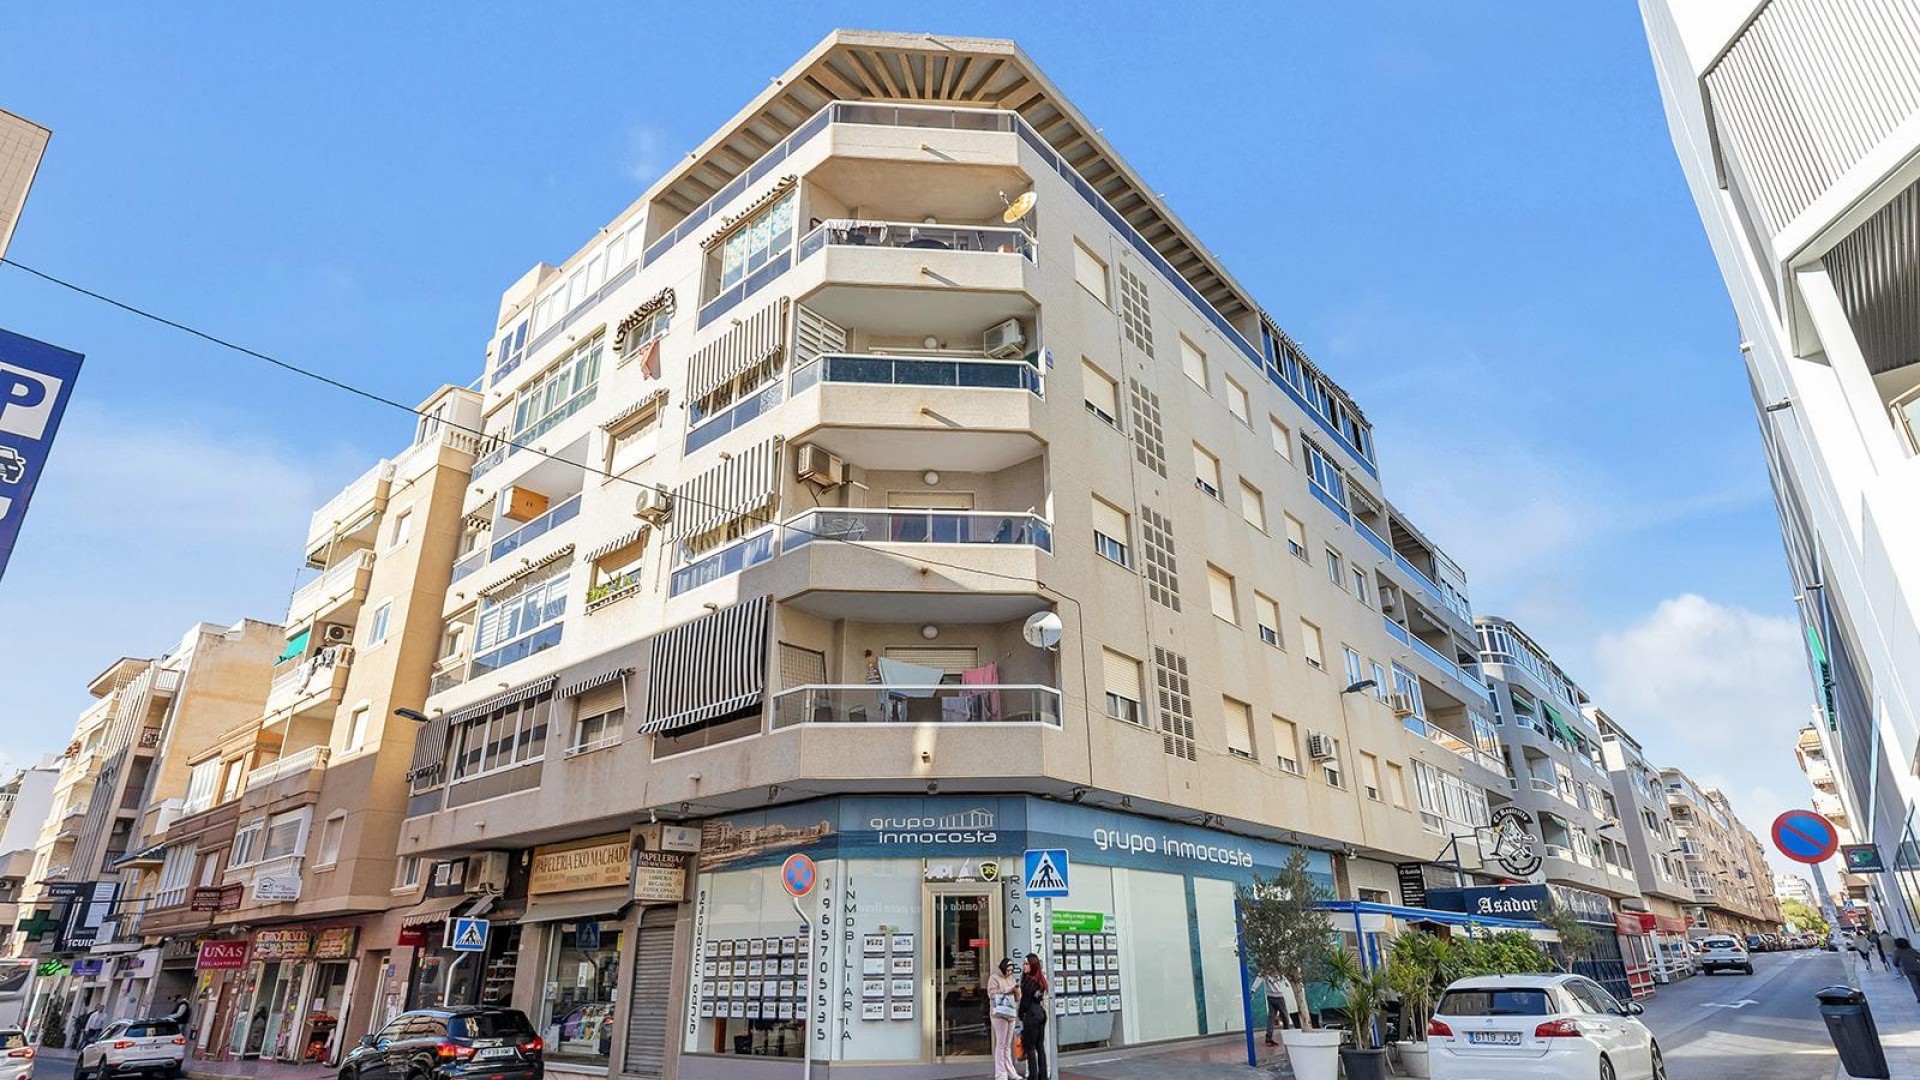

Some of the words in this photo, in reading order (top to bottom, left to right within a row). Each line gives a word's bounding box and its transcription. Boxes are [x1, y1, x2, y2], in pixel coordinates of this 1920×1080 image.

[0, 368, 46, 424] P
[870, 817, 936, 830] grupo
[879, 830, 997, 844] inmocosta
[1093, 828, 1157, 855] grupo
[1162, 835, 1254, 868] inmocosta
[1010, 875, 1021, 928] REAL
[1477, 896, 1538, 914] Asador
[204, 944, 244, 958] UÑAS
[689, 983, 698, 1035] grupo
[694, 890, 706, 977] inmocosta
[816, 897, 831, 1041] 965705535
[841, 877, 857, 1040] INMOBILIARIA
